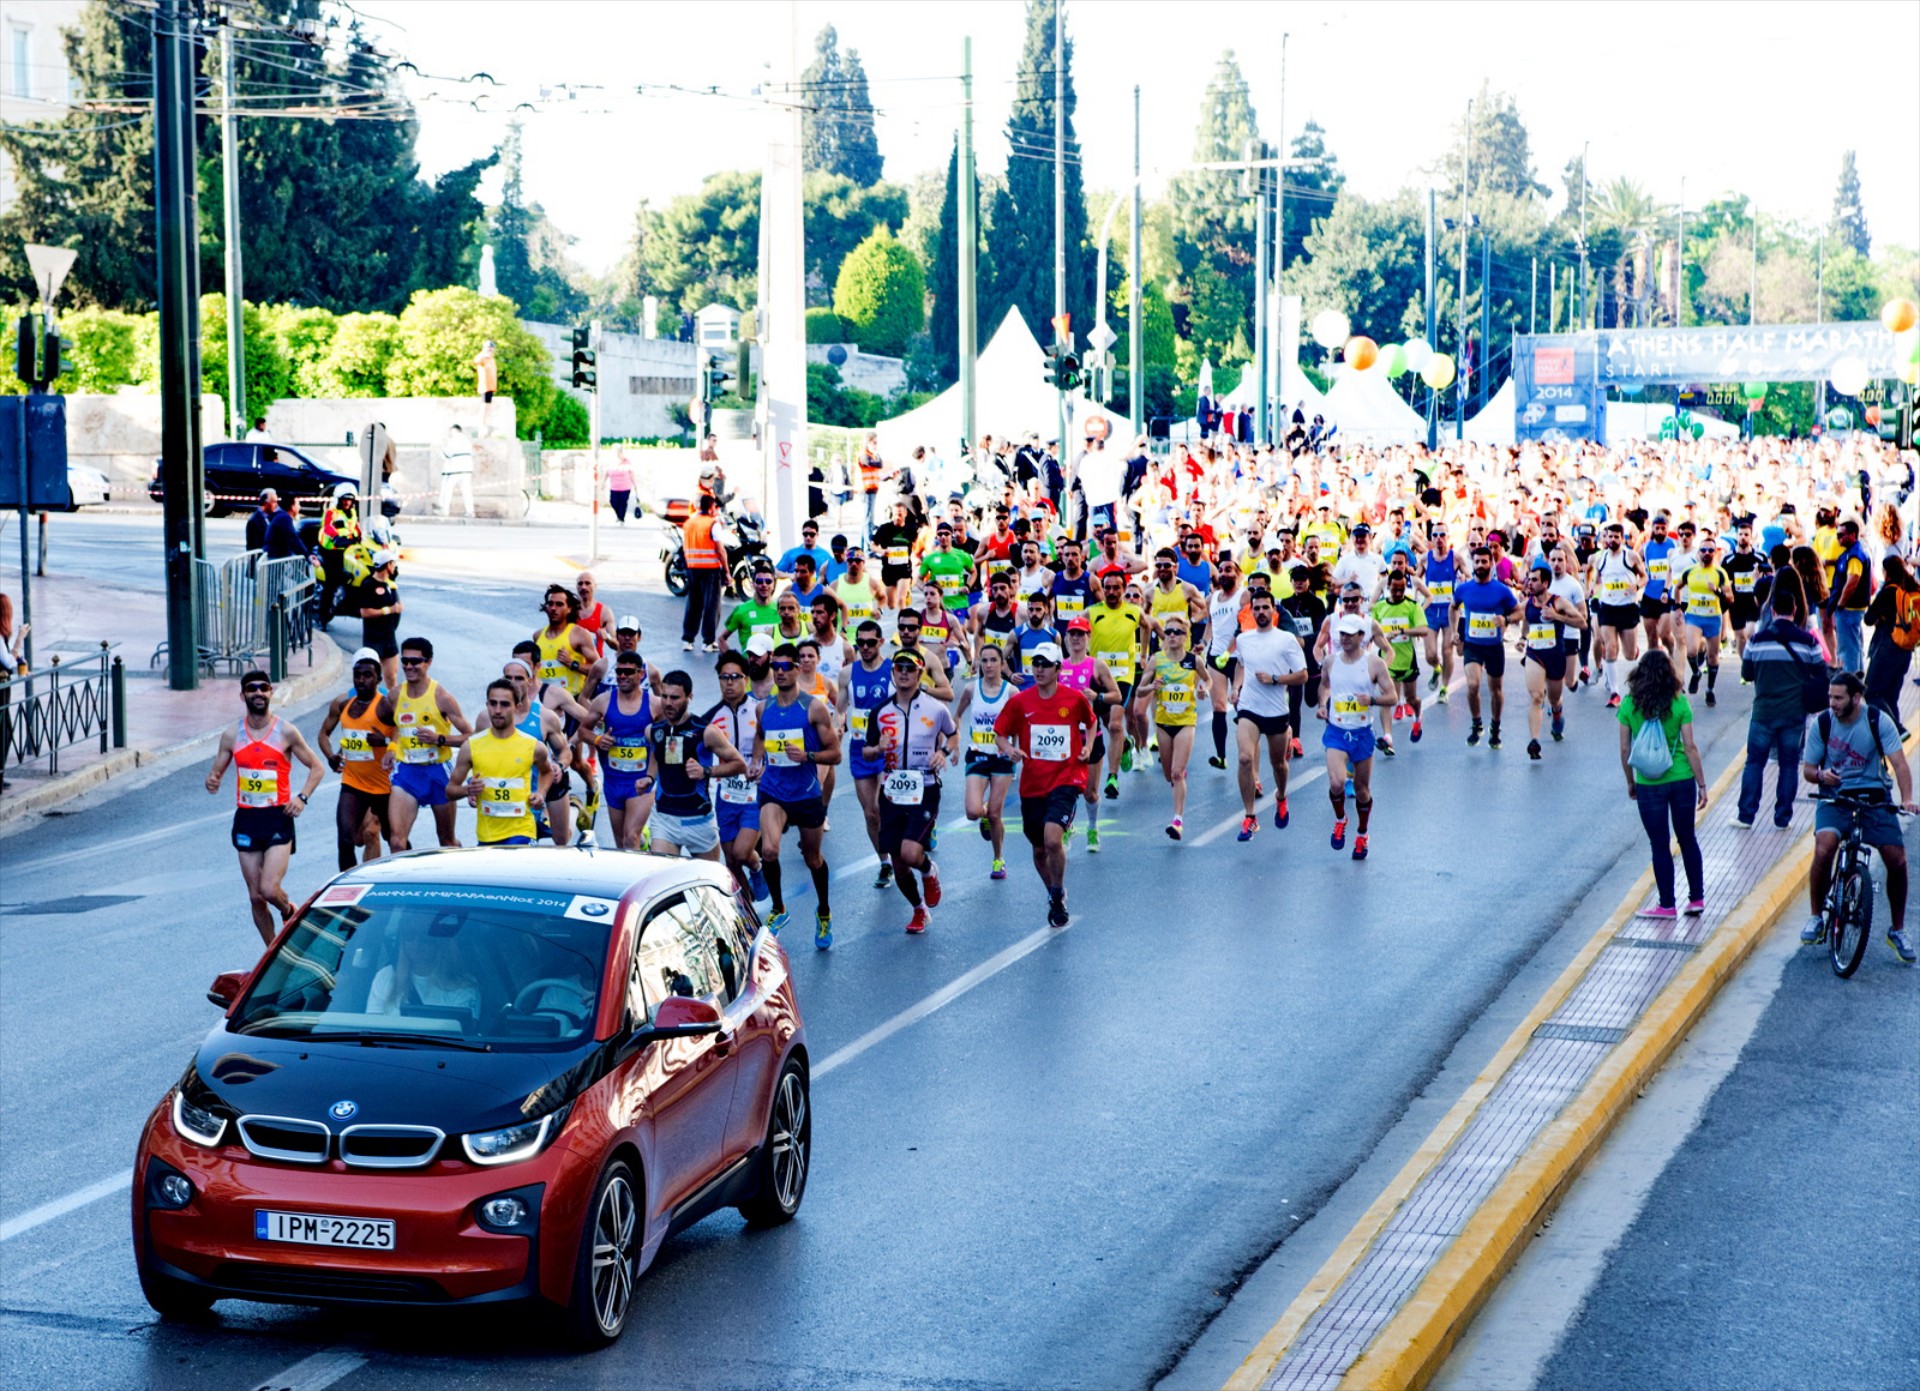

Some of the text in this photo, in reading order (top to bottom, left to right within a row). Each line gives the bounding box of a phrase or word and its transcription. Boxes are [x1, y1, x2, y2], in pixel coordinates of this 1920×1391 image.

[1606, 333, 1703, 357] ATHENS
[1712, 331, 1776, 356] HALF
[1606, 362, 1676, 378] START
[1535, 386, 1573, 400] 2014
[545, 668, 556, 677] 53
[1168, 691, 1184, 701] 107
[1345, 702, 1357, 711] 74
[1037, 735, 1065, 746] 2099
[620, 748, 634, 758] 56
[248, 780, 262, 791] 59
[726, 779, 751, 791] 2092
[890, 779, 917, 790] 2093
[494, 789, 510, 801] 58
[537, 899, 567, 908] 2014
